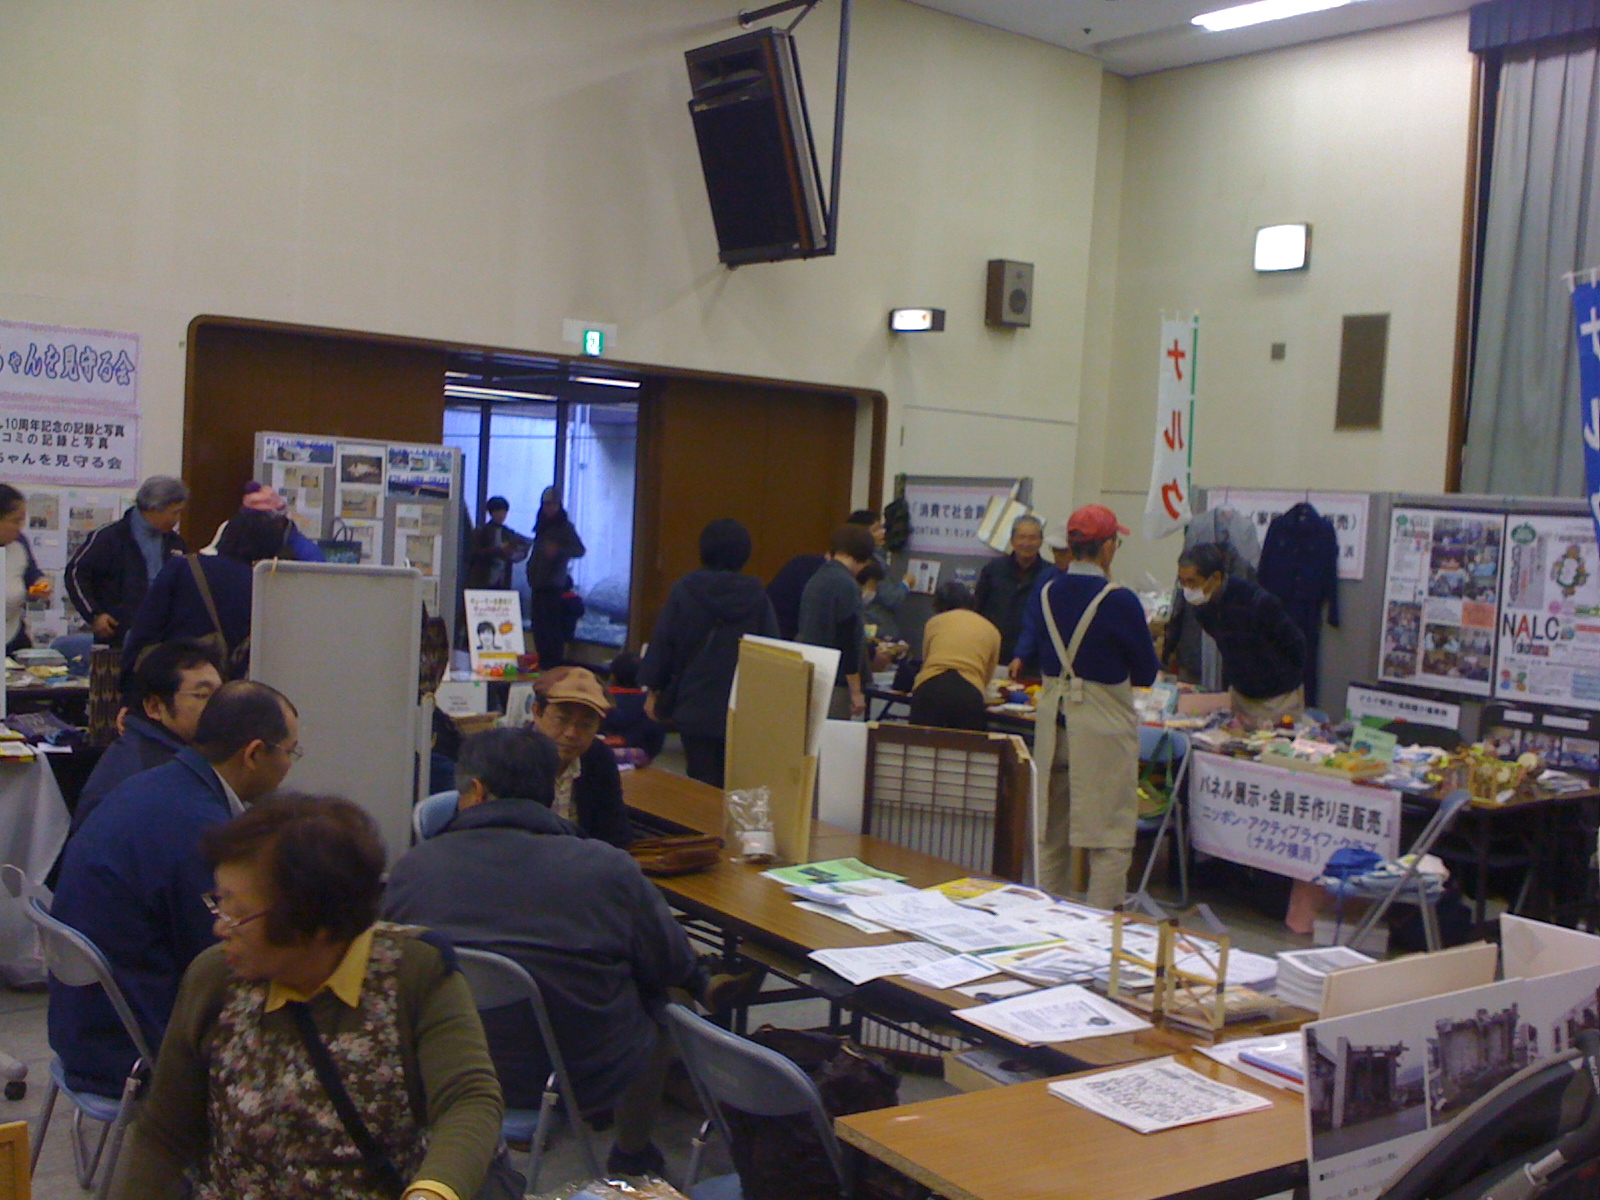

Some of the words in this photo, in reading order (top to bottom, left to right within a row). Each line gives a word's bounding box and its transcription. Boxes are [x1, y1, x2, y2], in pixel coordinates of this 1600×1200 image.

[0, 343, 135, 386] ゃんを見守る会
[0, 418, 125, 437] 10周年記念の記録と写真
[1502, 613, 1560, 641] NALC
